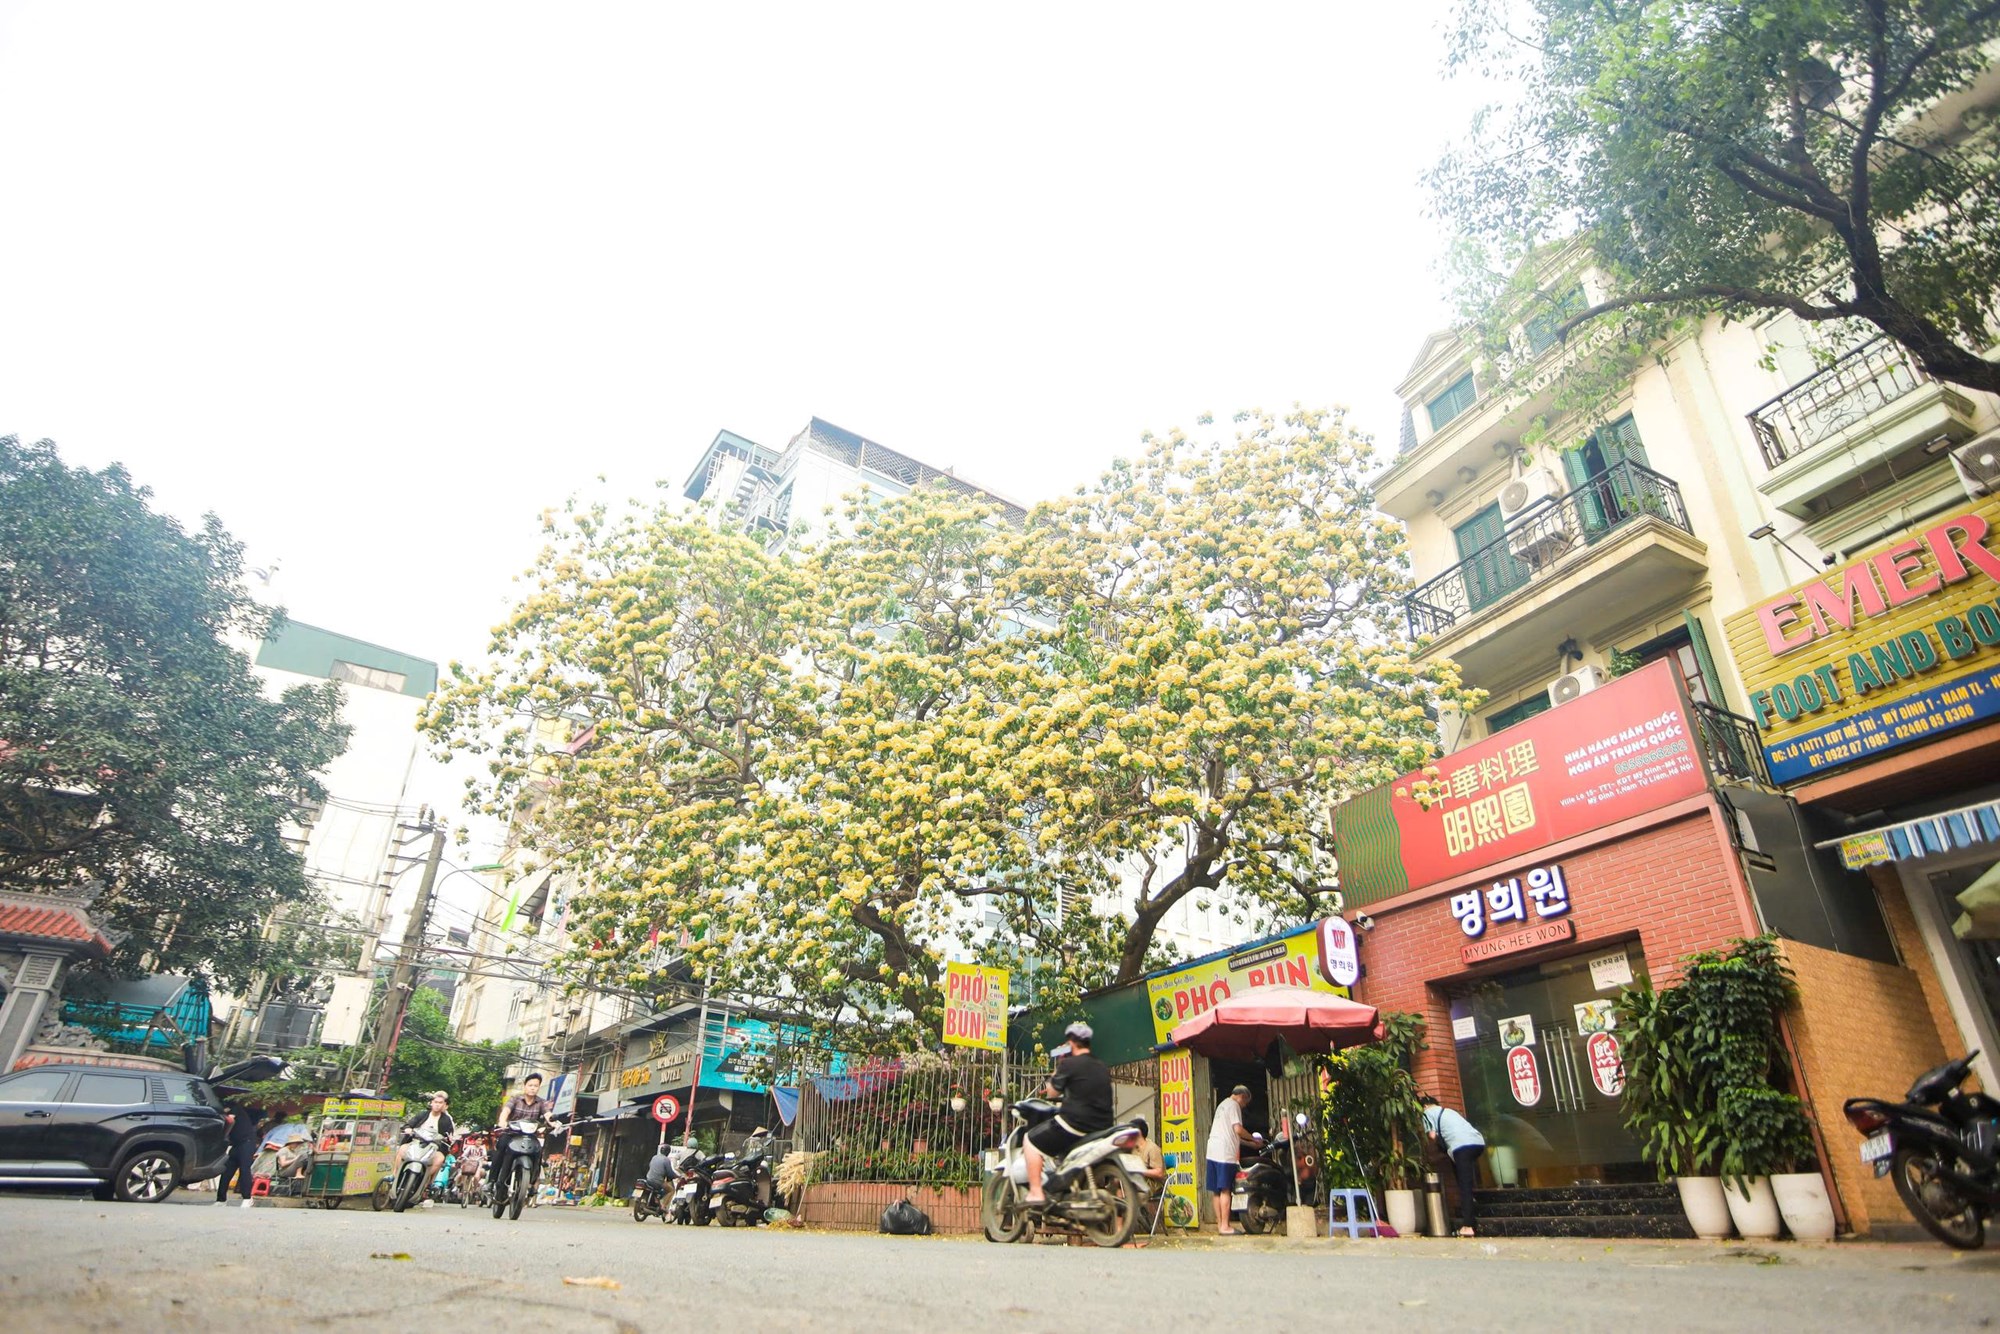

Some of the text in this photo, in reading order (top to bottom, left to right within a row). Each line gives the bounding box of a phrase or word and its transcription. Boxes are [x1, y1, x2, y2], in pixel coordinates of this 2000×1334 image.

[1756, 513, 2000, 657] EMER
[1750, 598, 2000, 730] FOOT AND BO
[1941, 686, 1970, 705] NAM
[1968, 682, 1984, 696] TL
[1564, 746, 1588, 763] NHÀ
[1587, 735, 1619, 754] HÀNG
[1619, 725, 1644, 741] HÀN
[1609, 738, 1648, 760] TRUNG
[1825, 744, 1849, 763] 0922
[1850, 739, 1862, 755] 07
[1863, 731, 1888, 751] 1985
[1431, 739, 1540, 809] 中華料理
[1450, 865, 1570, 937] 명희원
[1464, 924, 1567, 960] MYUNG HEE WON
[949, 967, 984, 1004] PHỞ
[946, 1005, 981, 1040] BÚN
[1162, 1053, 1190, 1084] BÚN
[1163, 1083, 1190, 1117] PHỞ
